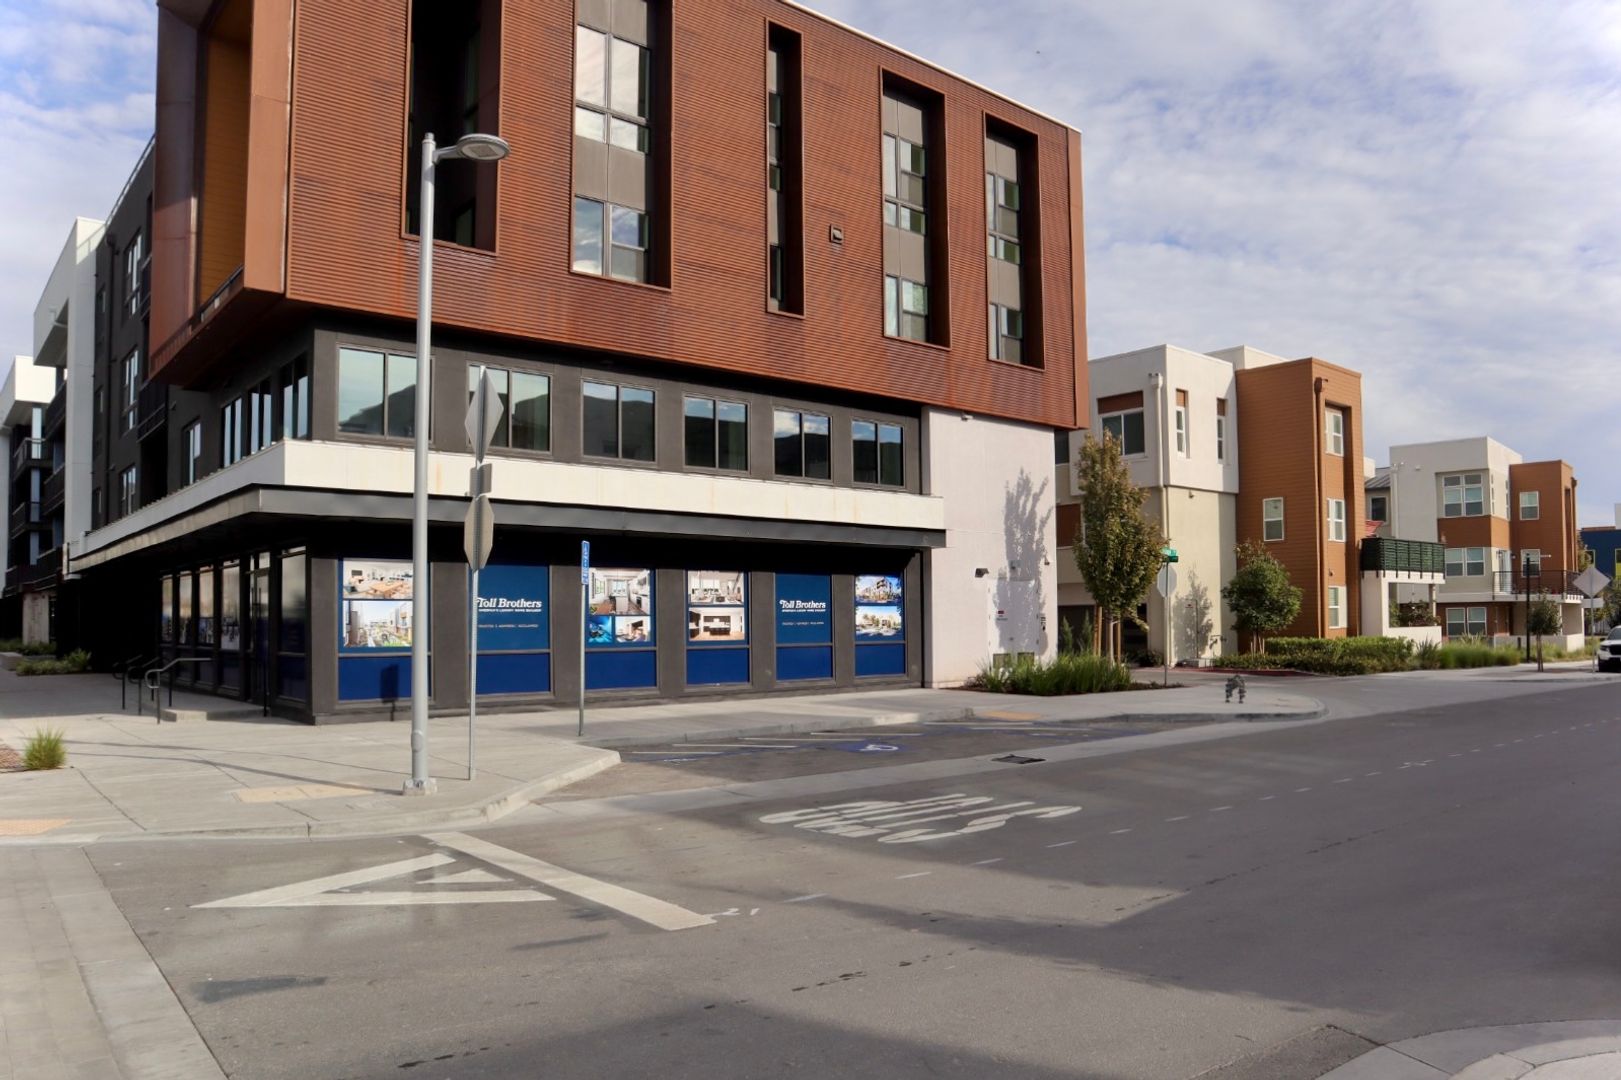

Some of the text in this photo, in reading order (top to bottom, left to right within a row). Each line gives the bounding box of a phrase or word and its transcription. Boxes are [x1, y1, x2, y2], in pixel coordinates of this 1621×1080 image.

[477, 597, 542, 608] Toll Brothers
[779, 599, 826, 609] Toll Brothers
[759, 793, 1082, 844] STOP
